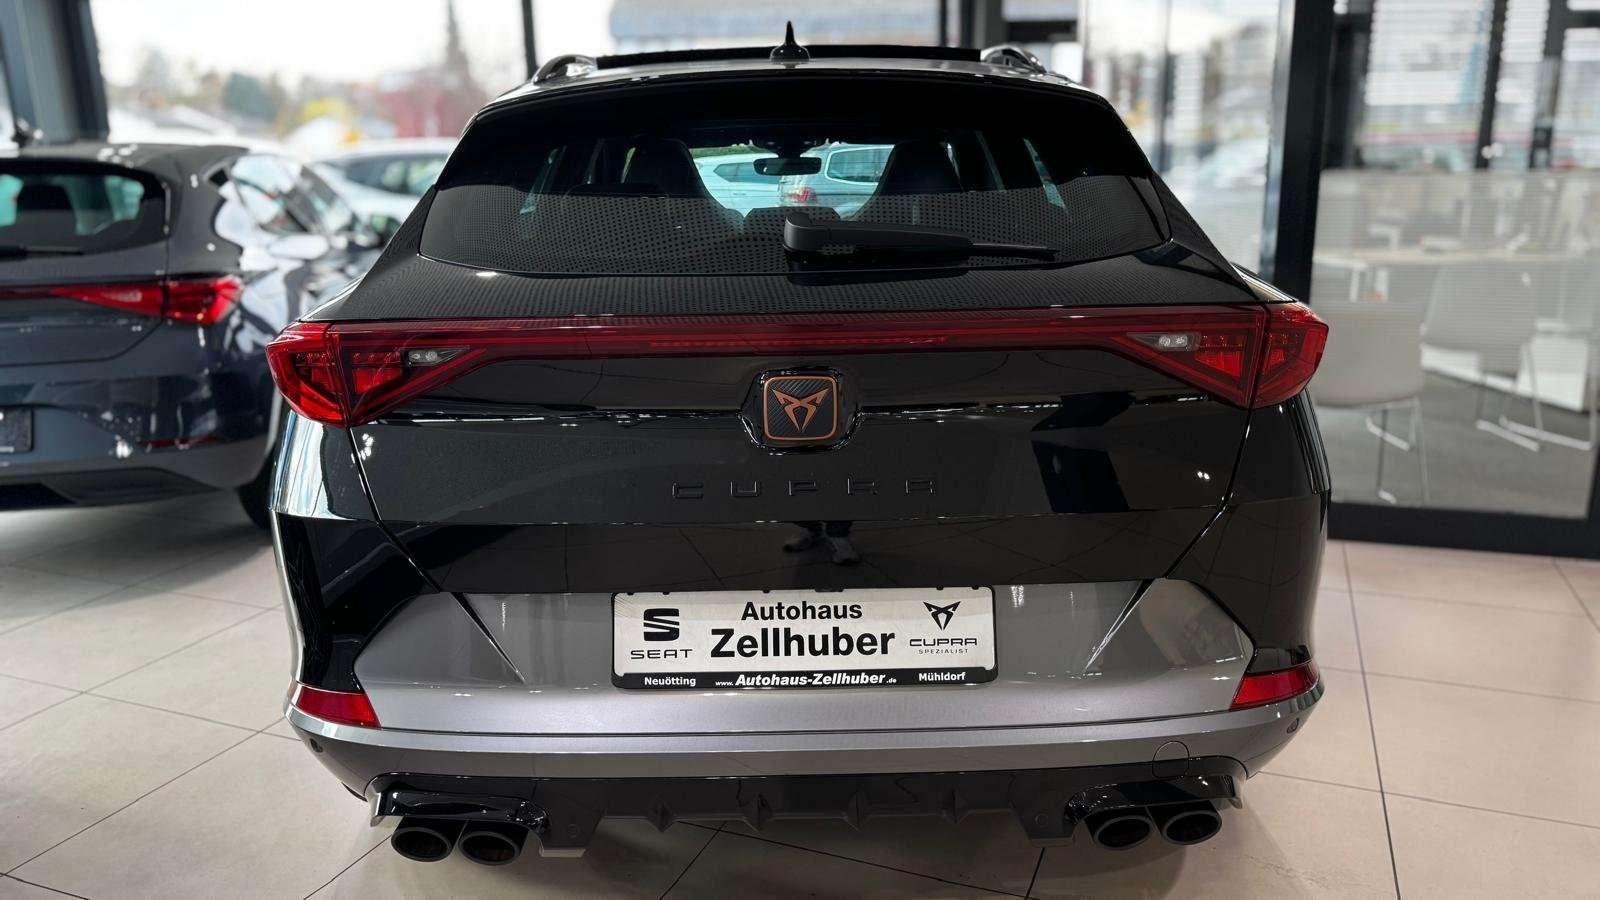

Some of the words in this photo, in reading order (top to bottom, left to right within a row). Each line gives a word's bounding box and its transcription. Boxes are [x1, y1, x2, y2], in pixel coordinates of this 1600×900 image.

[741, 601, 863, 621] Autohaus
[711, 627, 895, 659] Zellhuber
[909, 638, 977, 647] CUPRA
[630, 649, 693, 660] SEAT
[644, 676, 697, 688] Neuötting
[918, 671, 966, 683] Mühldorf
